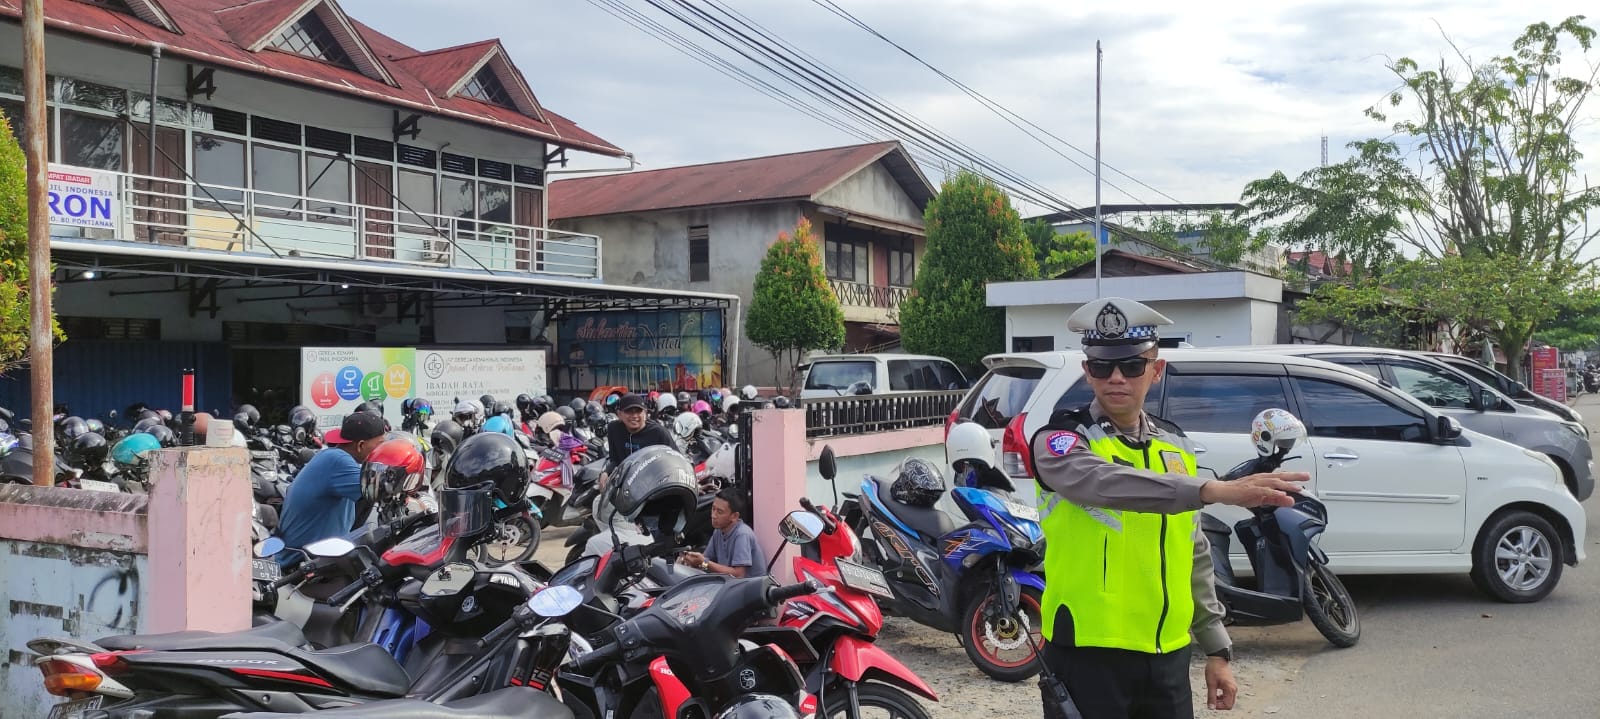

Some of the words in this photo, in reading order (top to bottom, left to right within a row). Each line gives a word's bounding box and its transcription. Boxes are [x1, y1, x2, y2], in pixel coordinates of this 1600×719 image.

[65, 174, 90, 183] IBADAH
[66, 185, 113, 196] INDONESIA
[72, 218, 114, 227] PONTIANAK
[425, 382, 459, 390] IBADAH
[462, 381, 485, 389] RAYA
